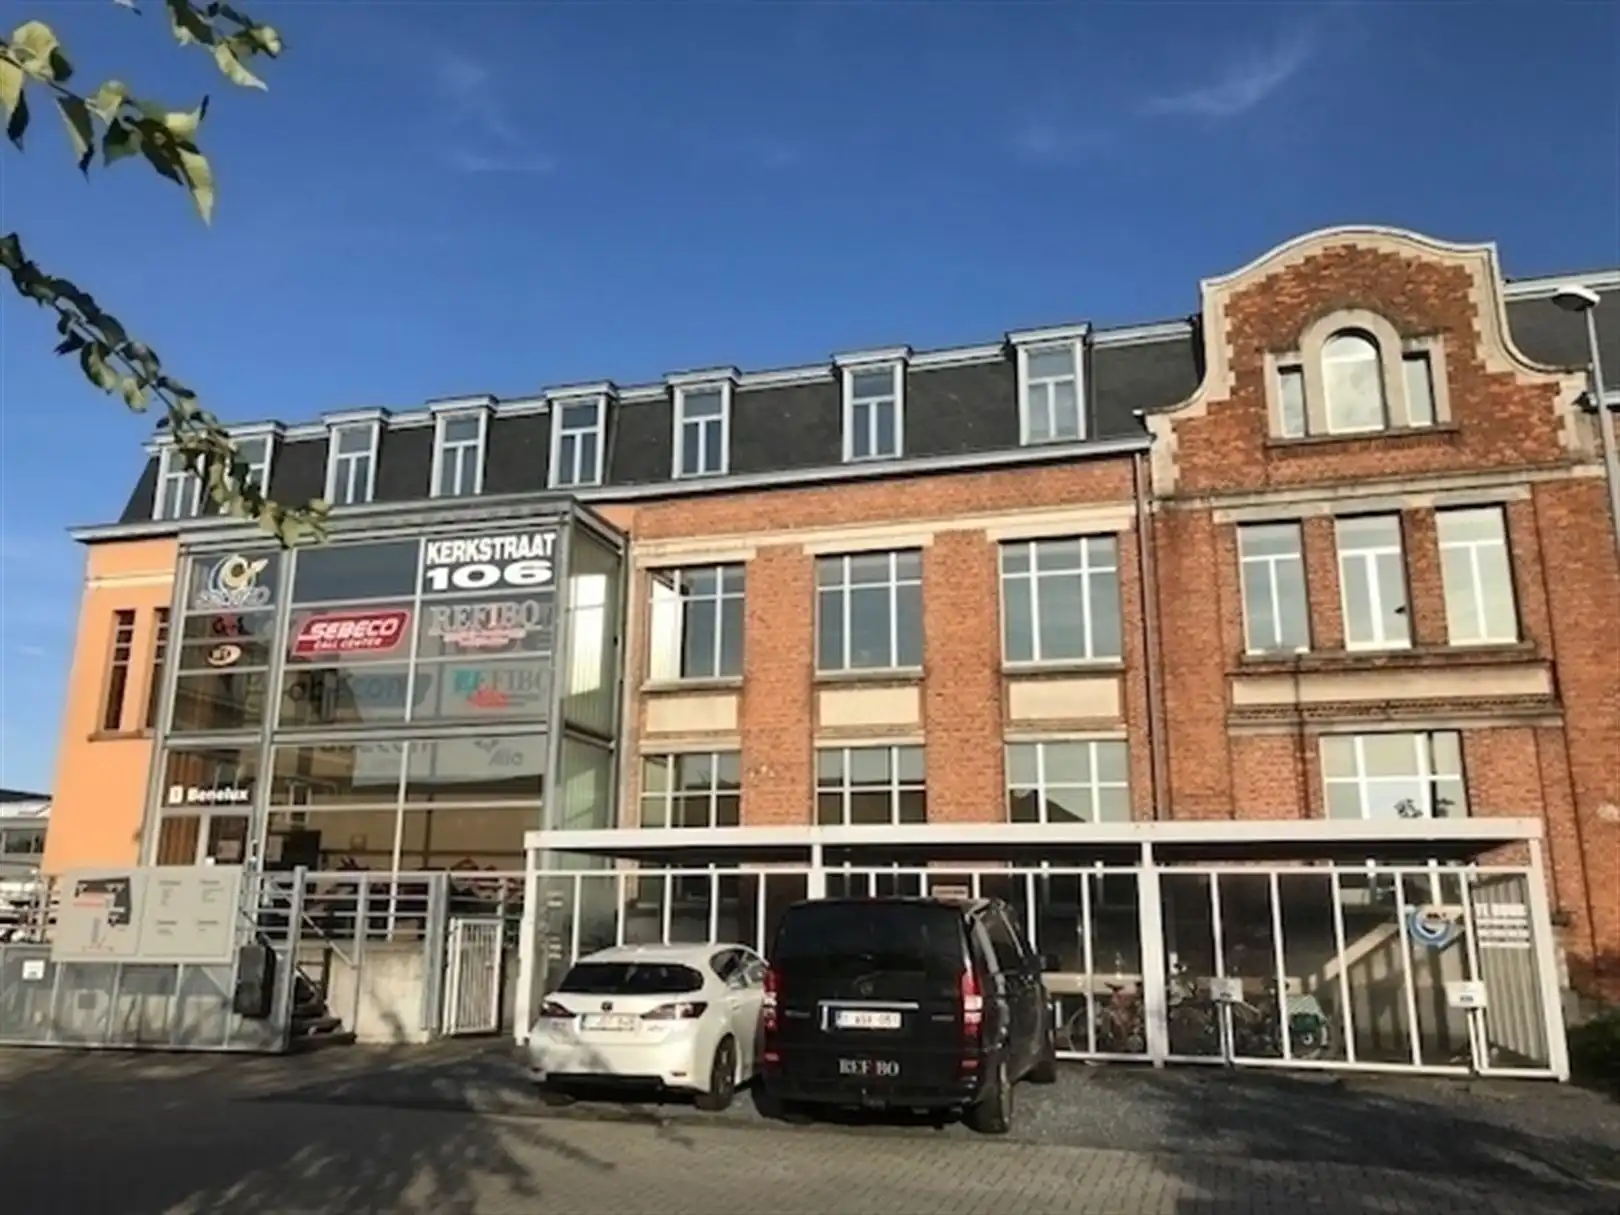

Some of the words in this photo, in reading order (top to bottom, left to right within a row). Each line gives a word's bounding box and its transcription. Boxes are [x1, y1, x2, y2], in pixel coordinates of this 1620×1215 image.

[427, 533, 556, 565] KERKSTRAAT
[427, 560, 552, 591] 106
[301, 618, 399, 639] SEBECO
[428, 599, 543, 636] REFIBO
[187, 786, 249, 803] Benelux
[838, 1057, 900, 1077] REFBO
